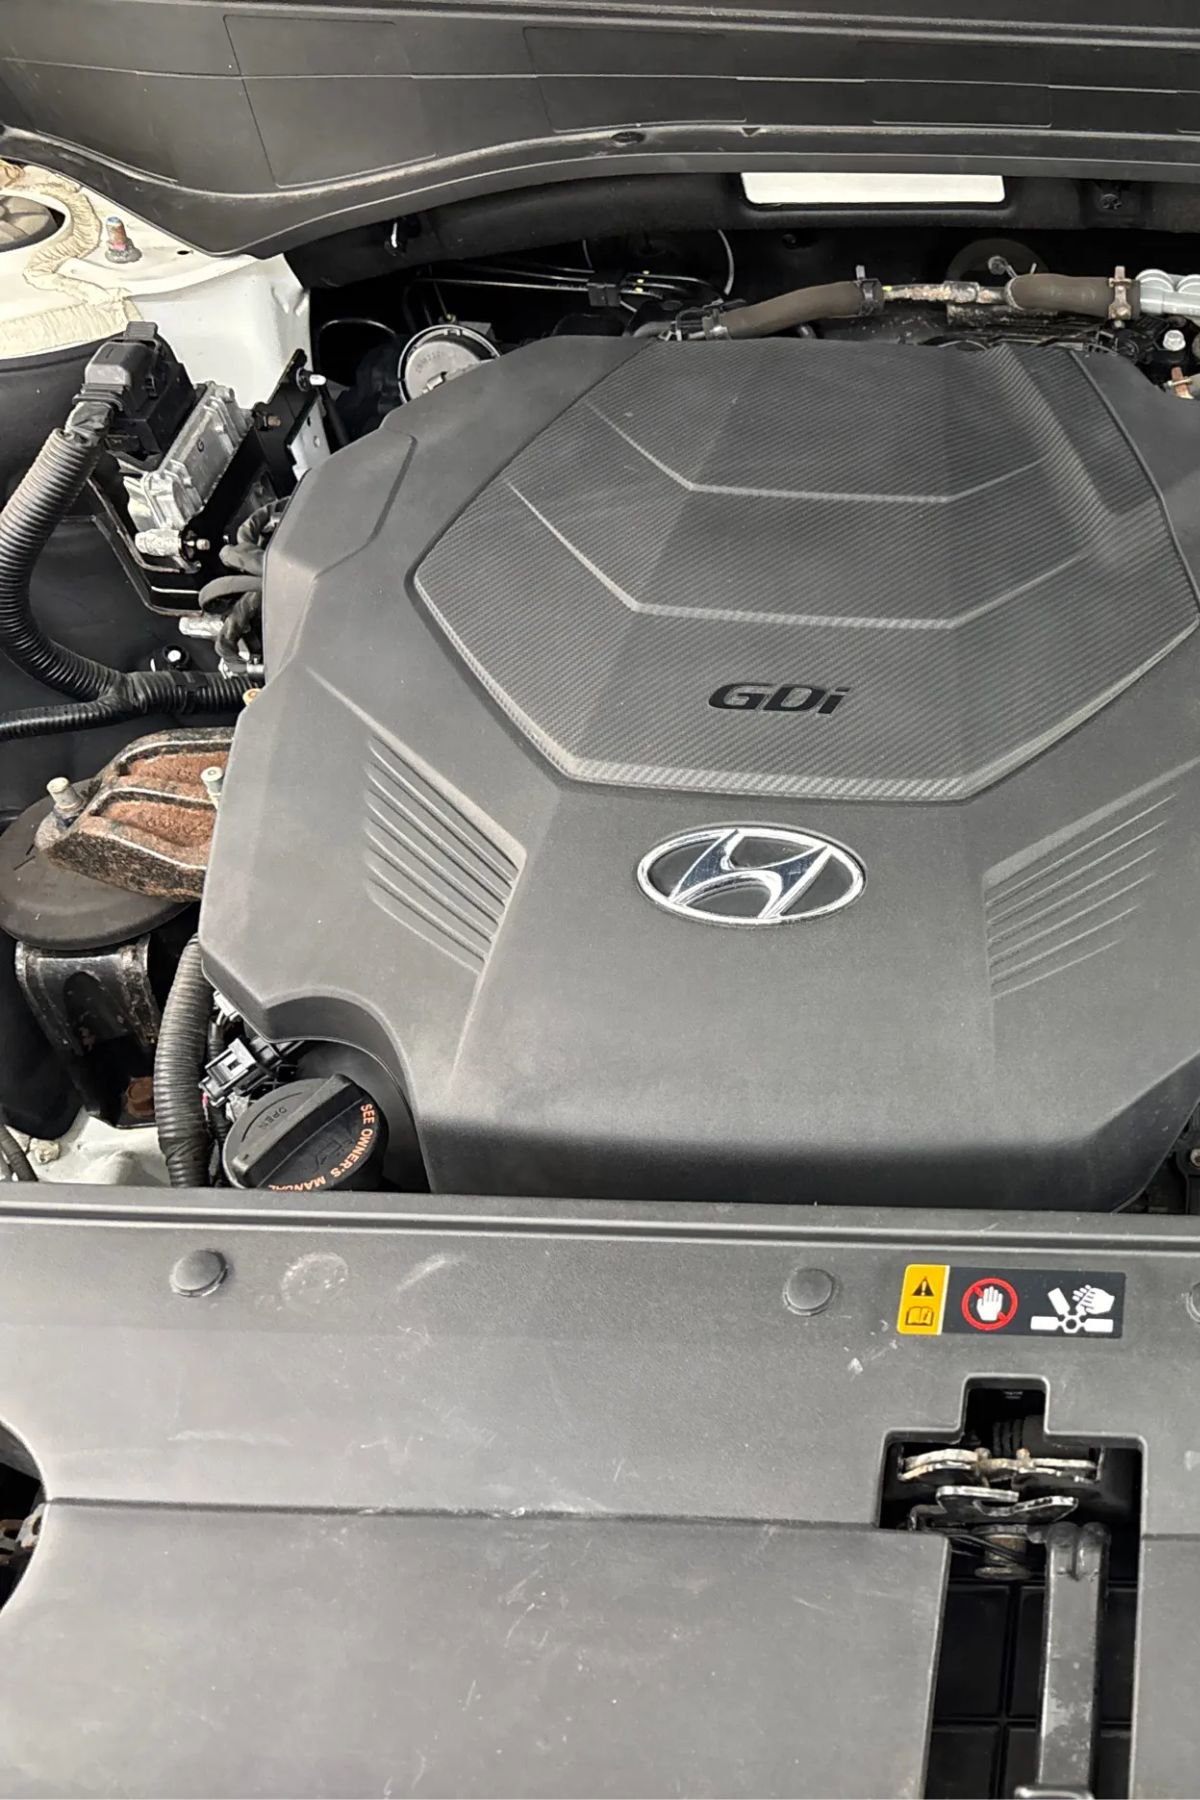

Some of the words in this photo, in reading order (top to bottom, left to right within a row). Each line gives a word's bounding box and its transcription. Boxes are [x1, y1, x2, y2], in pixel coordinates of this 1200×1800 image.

[708, 682, 851, 714] GDi
[360, 1103, 375, 1125] SEE
[330, 1128, 373, 1178] OWNER'S
